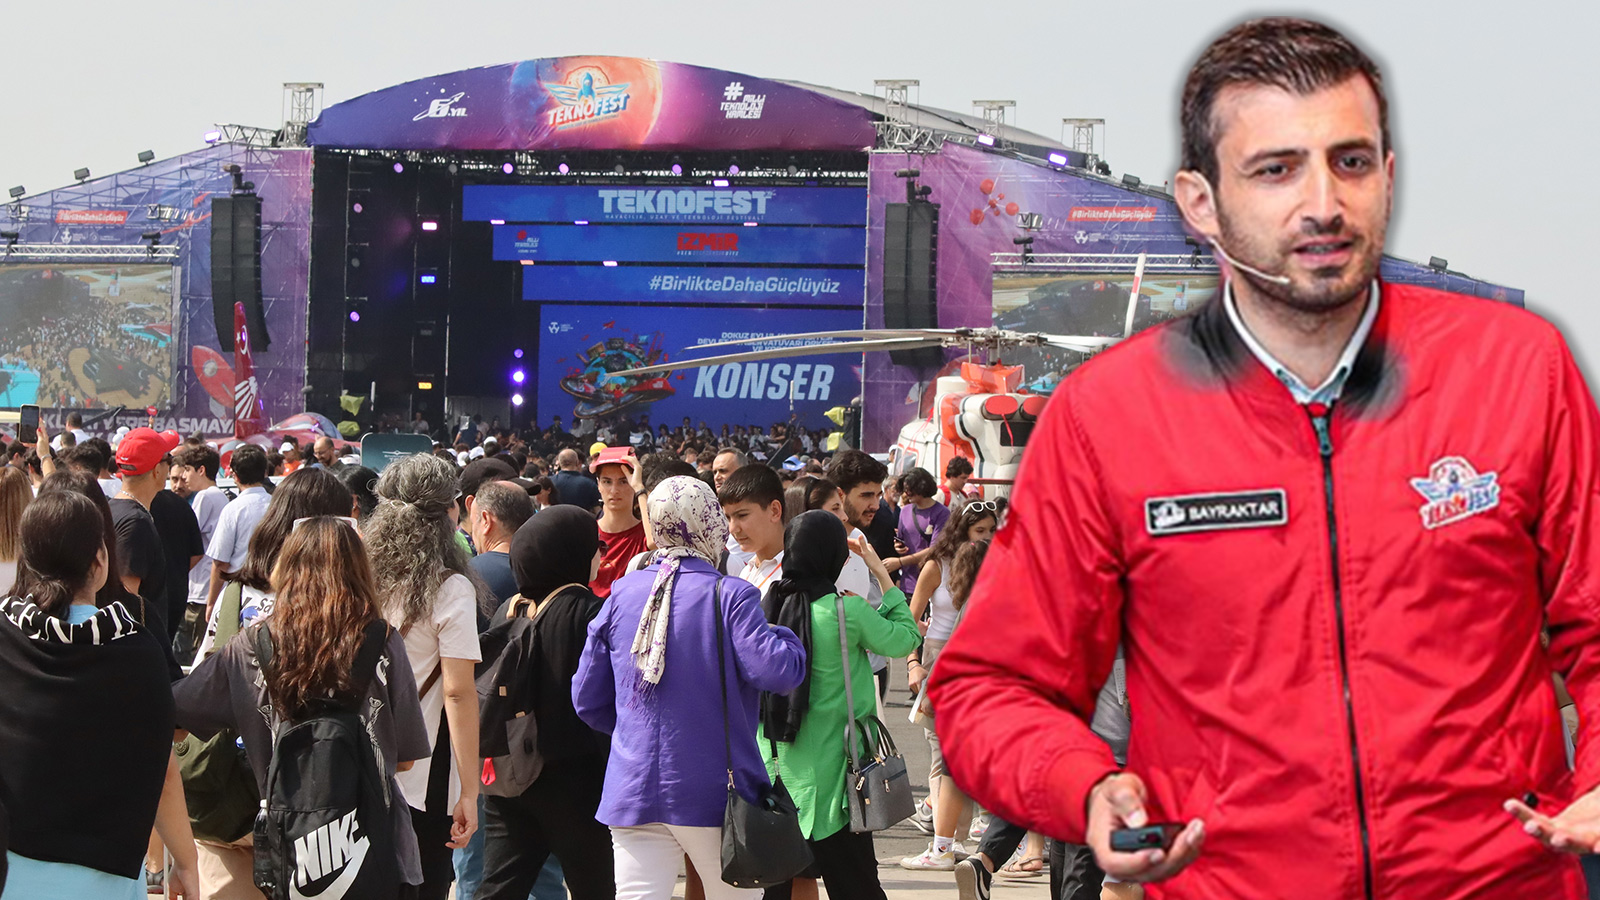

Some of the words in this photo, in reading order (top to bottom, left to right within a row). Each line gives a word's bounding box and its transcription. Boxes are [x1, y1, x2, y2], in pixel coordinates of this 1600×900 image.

[547, 93, 631, 128] TEKNOFEST
[599, 190, 772, 215] TEKNOFEST
[649, 275, 840, 296] #BirlikteDahaGüçlüyüz
[693, 362, 835, 401] KONSER
[1188, 501, 1280, 520] BAYRAKTAR
